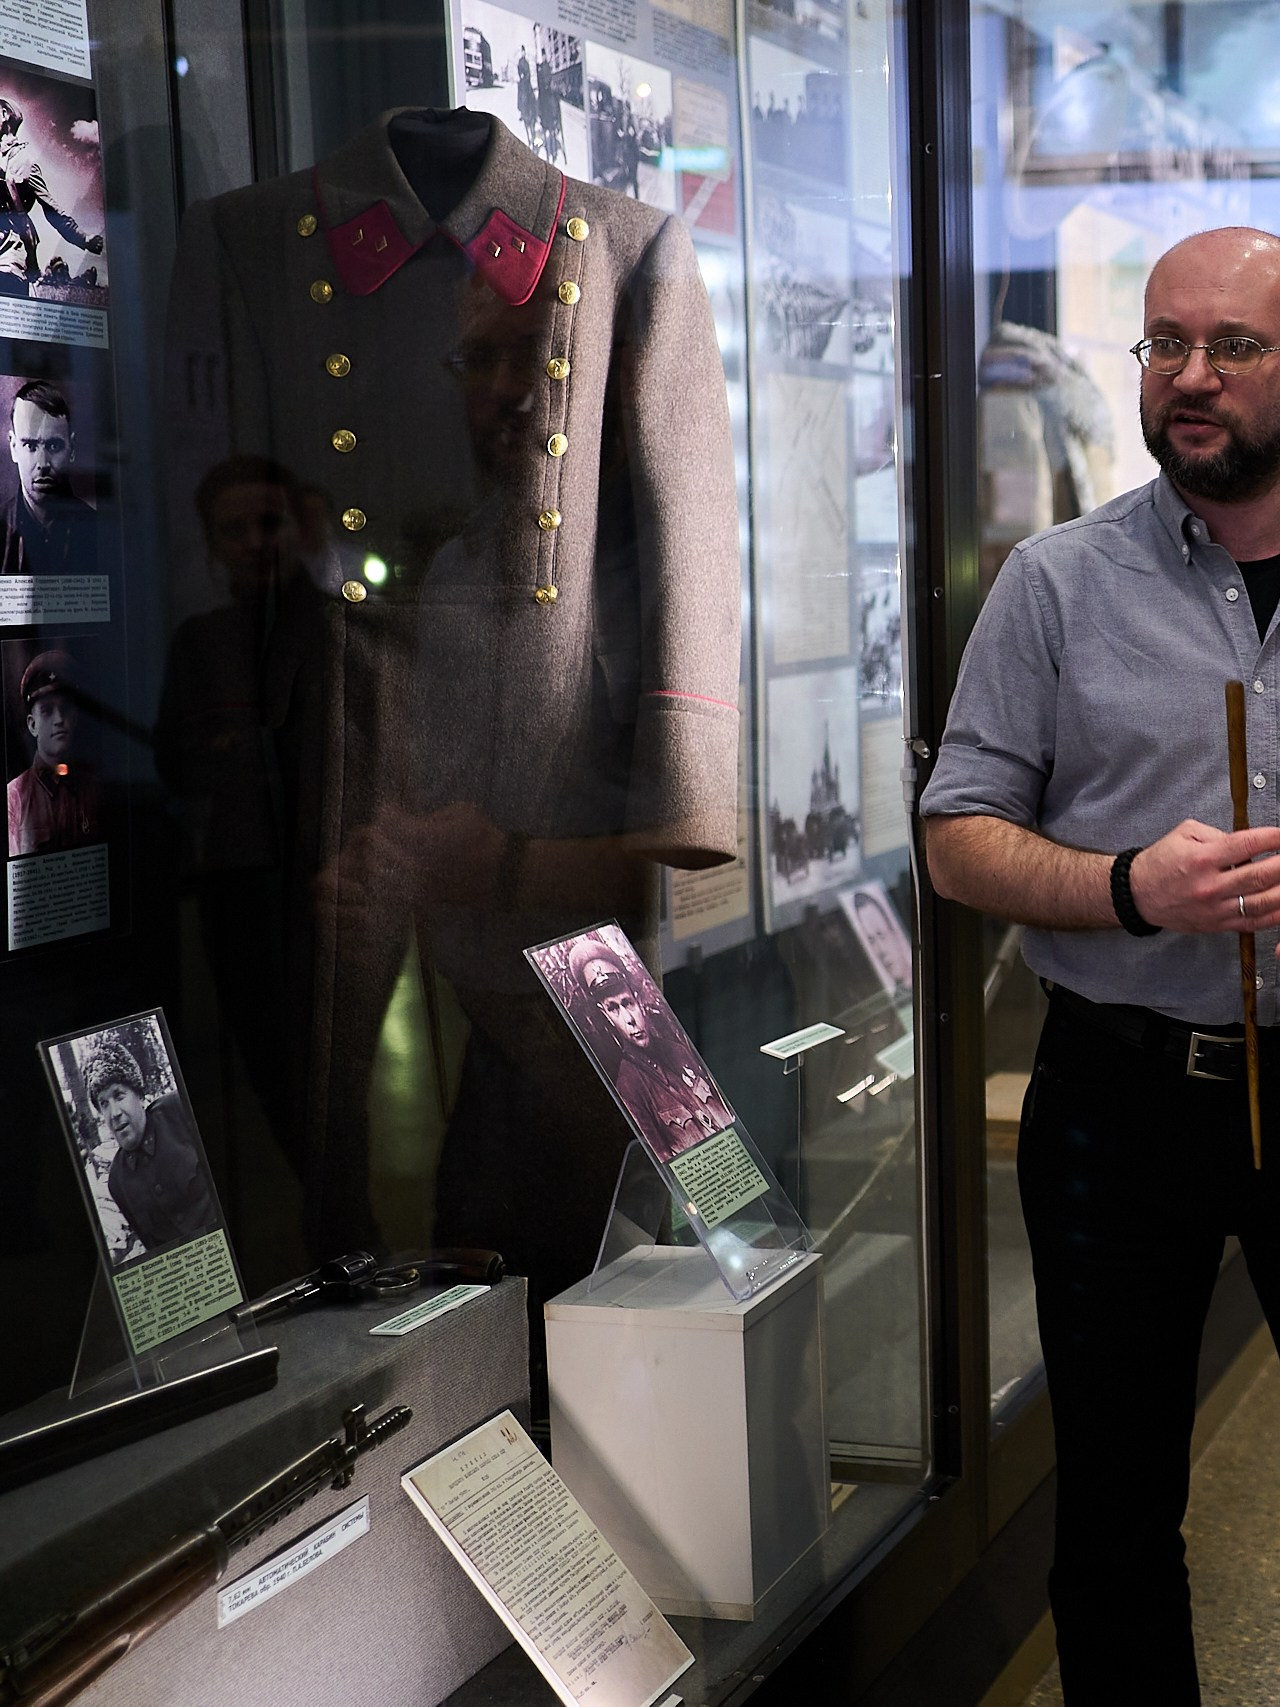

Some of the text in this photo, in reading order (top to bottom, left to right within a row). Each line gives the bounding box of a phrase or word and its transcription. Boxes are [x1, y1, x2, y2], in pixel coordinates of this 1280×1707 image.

[258, 1548, 308, 1586] АВТОМАТИЧЕСКИЙ
[313, 1530, 335, 1549] КАРАБИН
[341, 1512, 363, 1530] СИСТЕМЫ
[228, 1588, 257, 1612] ТОКАРЕВА
[260, 1582, 270, 1593] обр.
[273, 1572, 285, 1584] 1940
